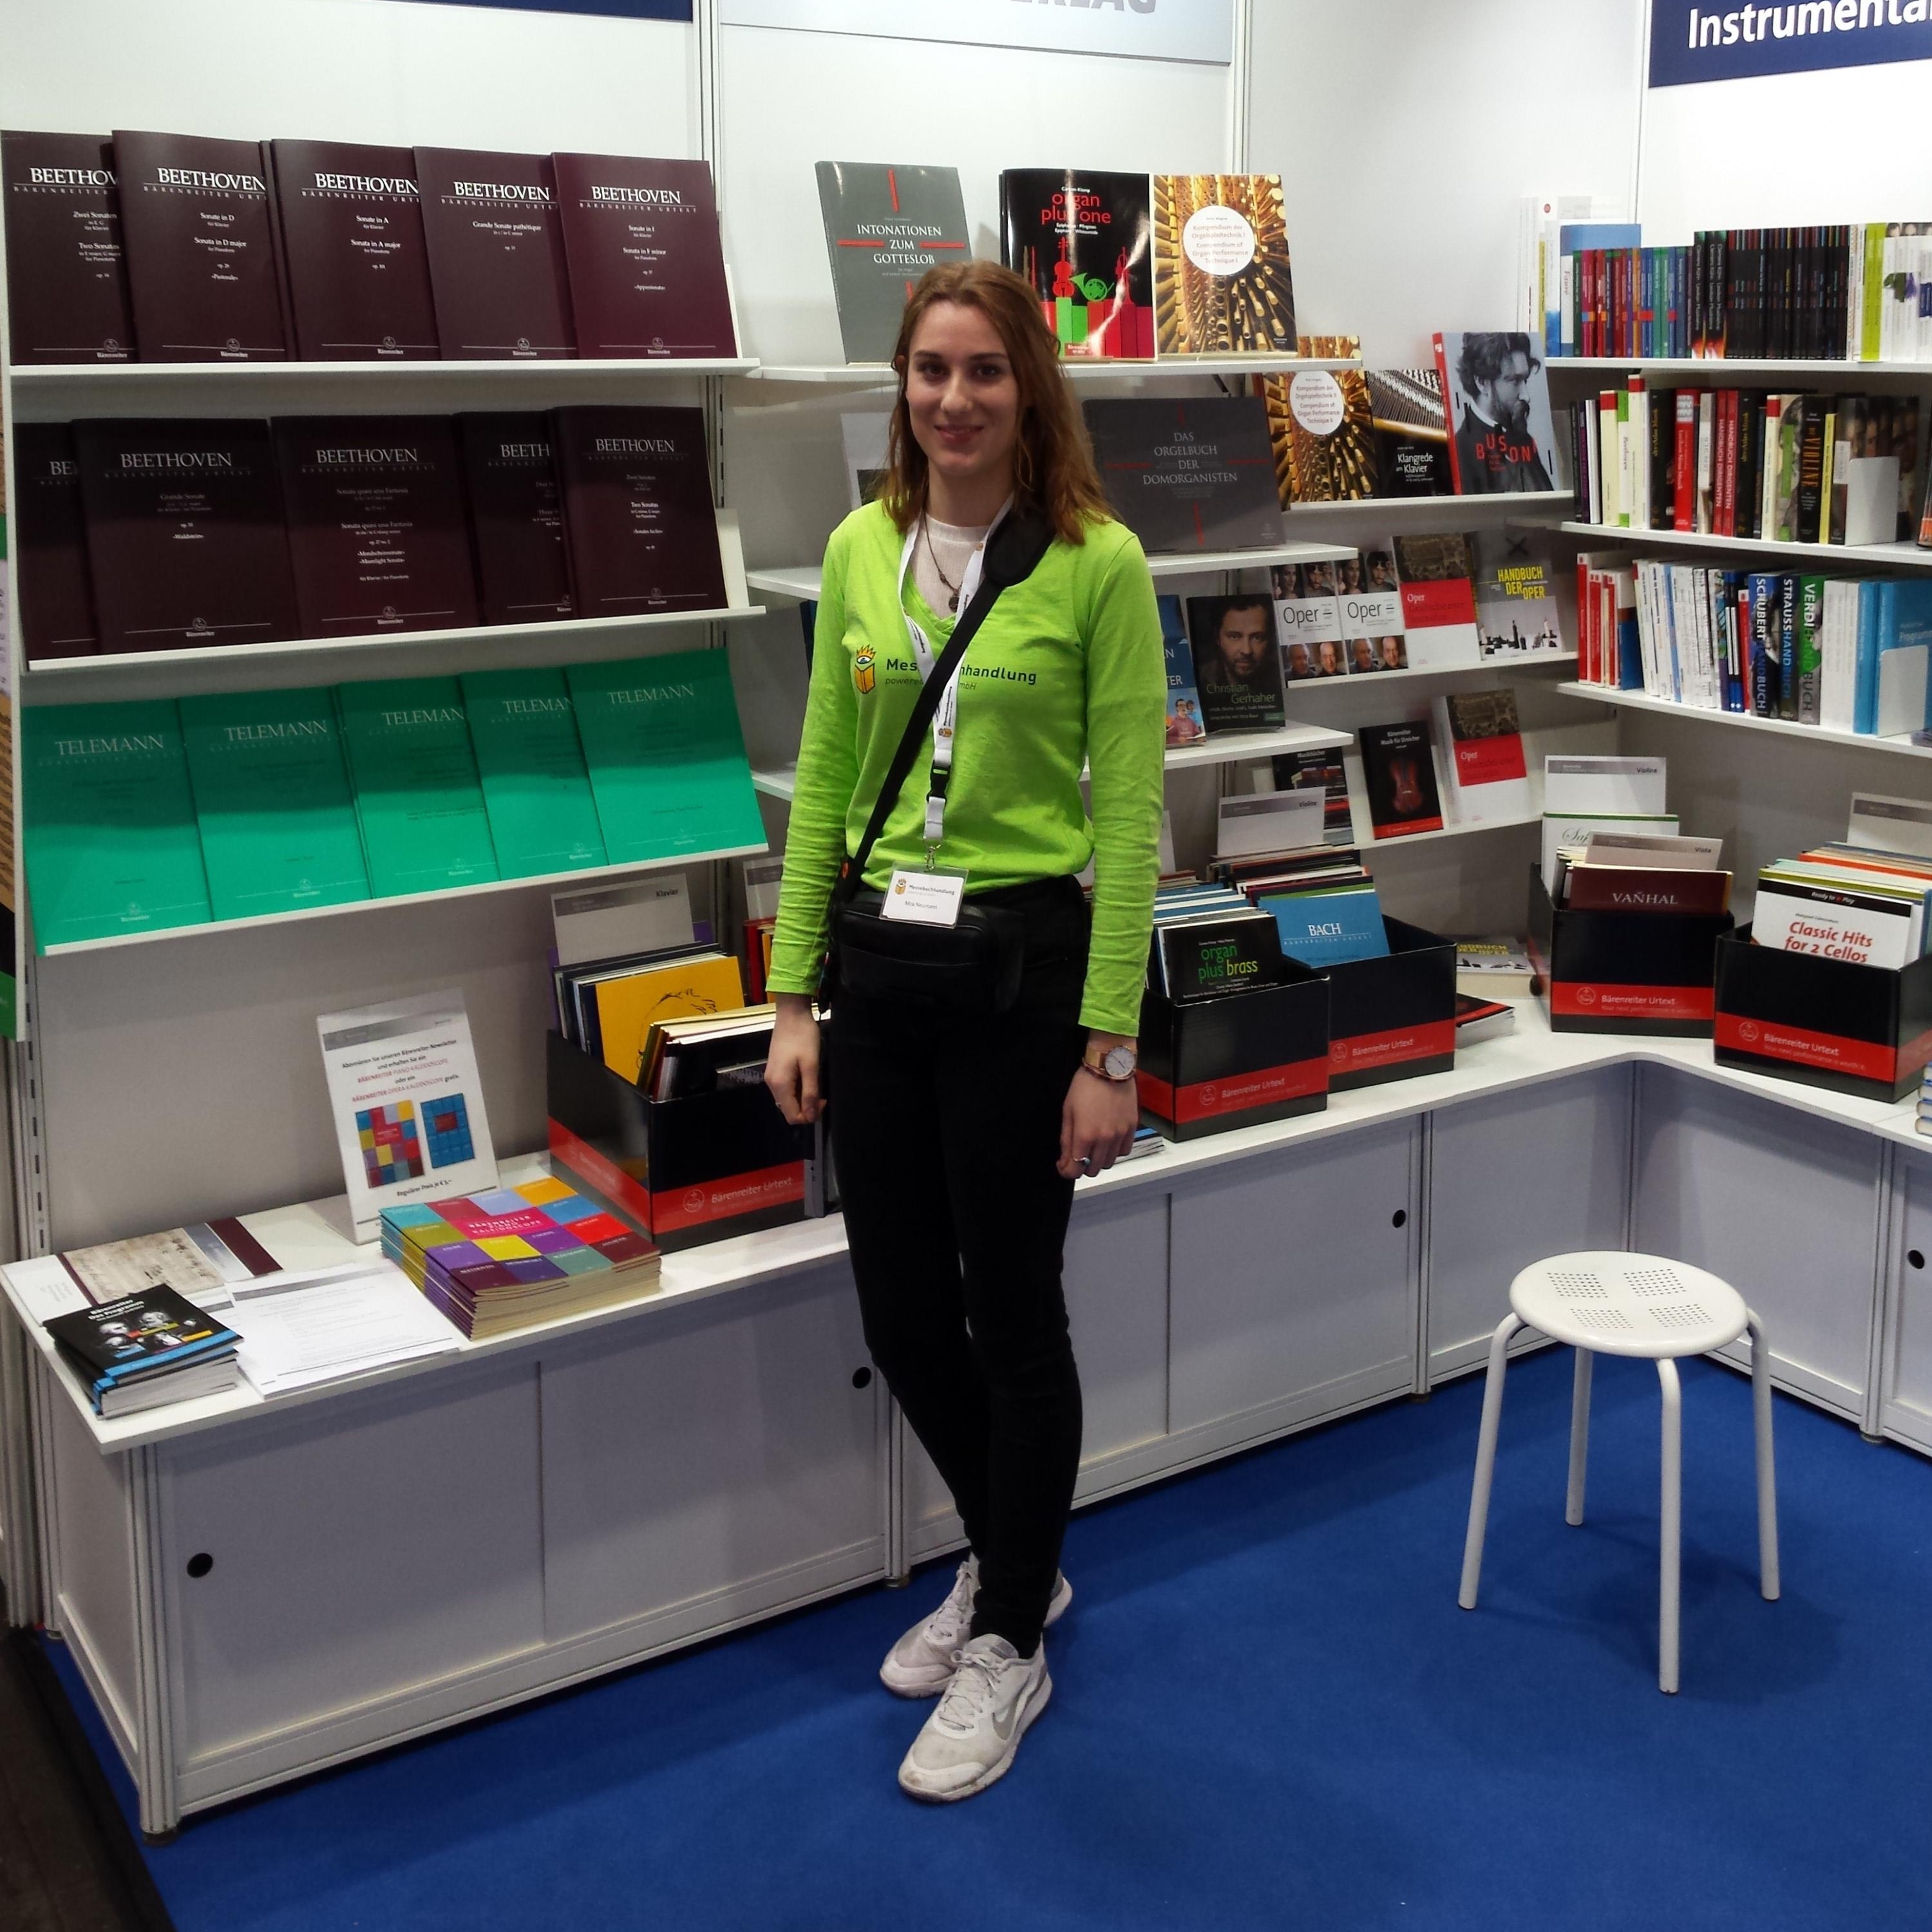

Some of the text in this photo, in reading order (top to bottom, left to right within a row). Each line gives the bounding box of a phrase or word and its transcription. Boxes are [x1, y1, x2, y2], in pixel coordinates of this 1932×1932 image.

[1689, 0, 1932, 49] Instrumenta
[157, 167, 265, 191] BEETHOVEN
[314, 173, 419, 194] BEETHOVEN
[454, 181, 550, 201] BEETHOVEN
[591, 186, 681, 204] BEETHOVEN
[1052, 194, 1100, 210] ogan
[200, 213, 220, 221] Sonate
[1079, 211, 1111, 223] one
[857, 224, 942, 236] INTONATIONEN
[889, 239, 914, 250] ZUM
[873, 253, 935, 264] GOTTESLOB
[1174, 432, 1194, 441] DAS
[596, 439, 674, 453] BEETHOVEN
[1154, 445, 1218, 457] ORGELBUCH
[120, 453, 232, 468] BEETHOVEN
[316, 448, 417, 463] BEETHOVEN
[1397, 453, 1434, 465] Klangrede
[1801, 437, 1821, 488] VIOLINE
[1178, 460, 1200, 469] DER
[1404, 464, 1427, 473] Klavier
[1143, 472, 1237, 484] DOMORGANISTEN
[1725, 464, 1734, 509] DIRIGENTEN
[1498, 566, 1543, 582] HANDBUCH
[1505, 582, 1522, 596] DER
[1522, 586, 1545, 600] OPER
[1407, 594, 1425, 603] Oper
[1283, 607, 1319, 629] Oper
[1347, 601, 1381, 623] Oper
[608, 683, 694, 704] TELEMANN
[1206, 684, 1249, 694] Christian
[1231, 694, 1276, 705] Gerhaher
[224, 719, 327, 741] TELEMANN
[55, 734, 164, 755] TELEMANN
[1461, 751, 1478, 761] Oper
[656, 887, 679, 898] Klavier
[1812, 891, 1828, 900] Ready
[1308, 923, 1341, 936] BACH
[1789, 922, 1873, 947] Classic Hits
[1201, 945, 1237, 963] organ
[1785, 936, 1868, 963] for 2 Cellos
[1198, 959, 1258, 984] plus brass
[1602, 995, 1646, 1004] Bärenreiter
[1352, 1038, 1413, 1056] Bärenreiter Urtext
[1764, 1034, 1839, 1056] Bärenreiter Urtext
[1221, 1077, 1285, 1098] Bärenreiter Urtext
[711, 1177, 793, 1204] Bärenreiter Urtext
